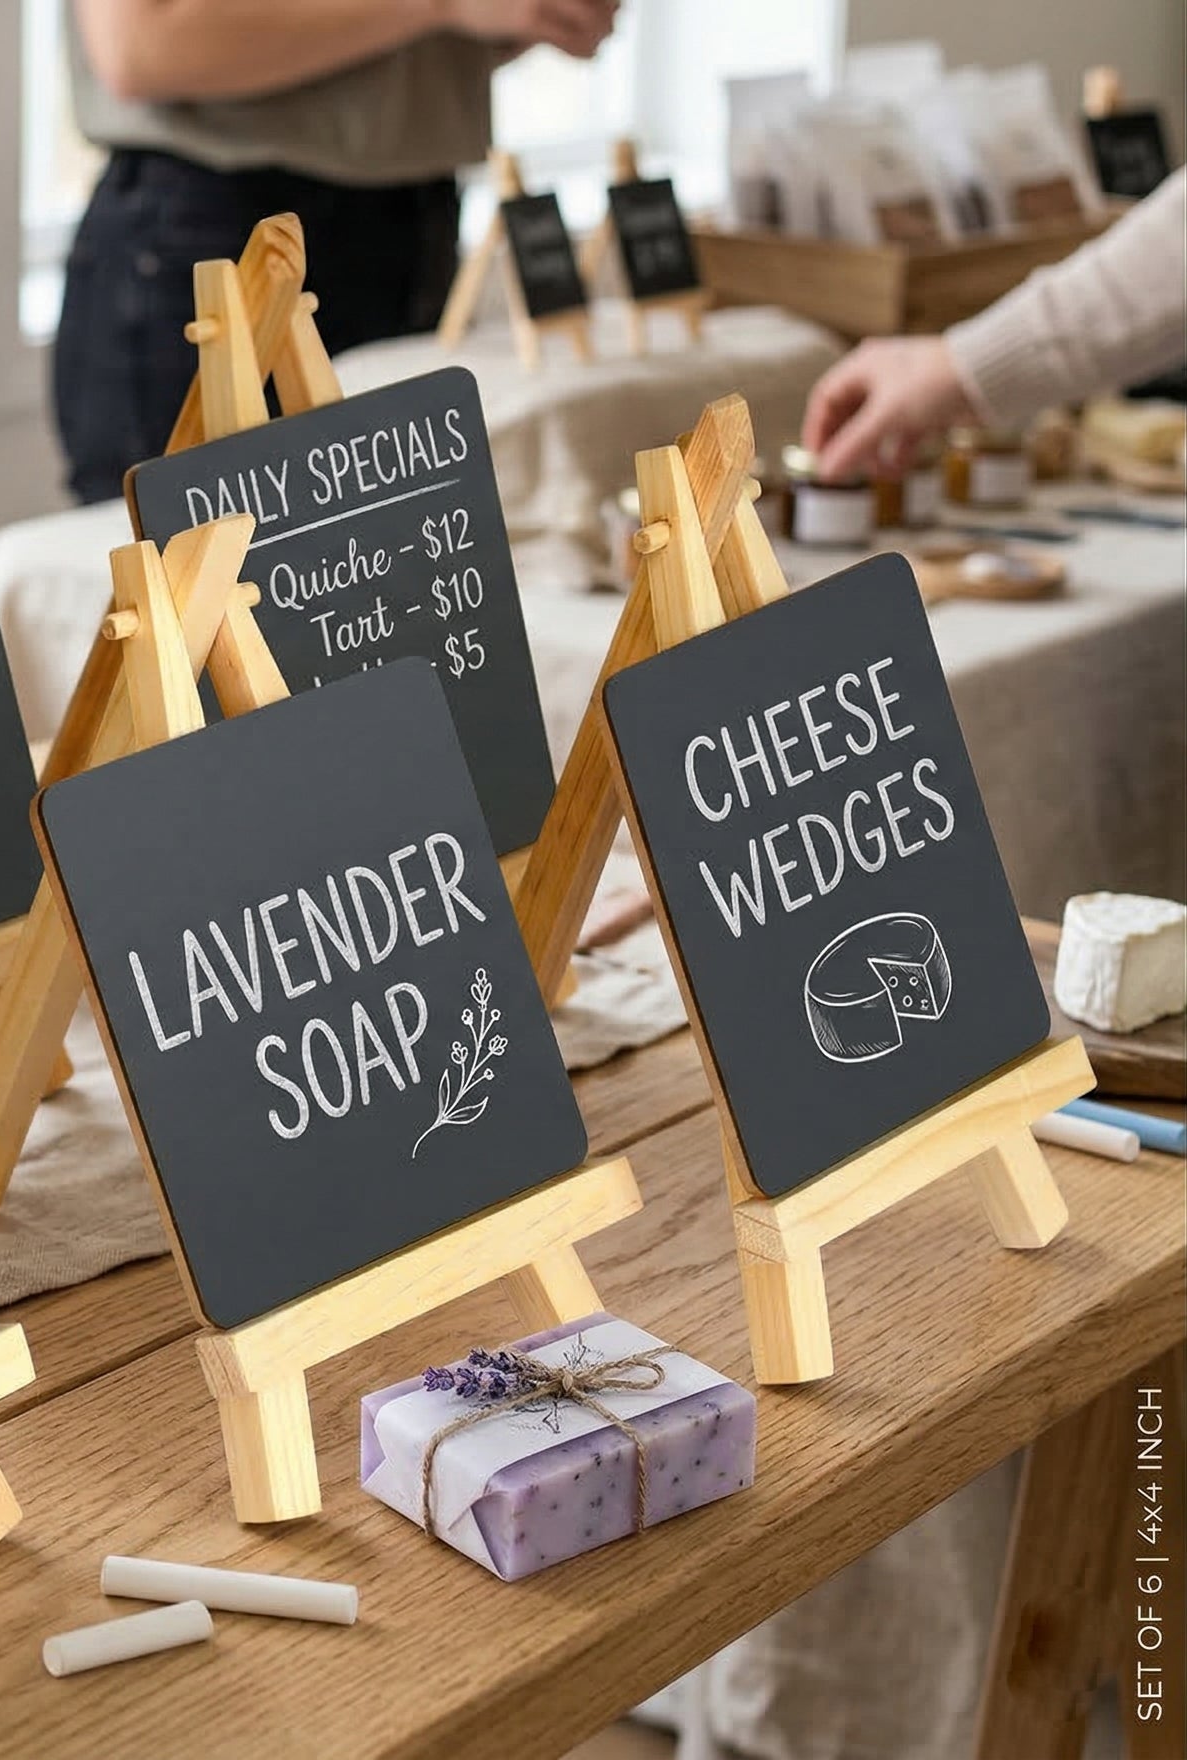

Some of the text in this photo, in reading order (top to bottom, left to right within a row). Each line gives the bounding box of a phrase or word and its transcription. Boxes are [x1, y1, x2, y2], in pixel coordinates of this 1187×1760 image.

[185, 408, 468, 528] DAILY SPECIALS
[269, 538, 392, 610] Quiche
[421, 508, 474, 562] $12
[310, 596, 394, 657] Tart
[431, 567, 483, 620] $10
[444, 628, 485, 679] $5
[685, 657, 915, 822] CHEESE
[699, 758, 955, 938] WEDGES
[129, 833, 486, 1052] LAVENDER
[256, 982, 428, 1139] SOAP
